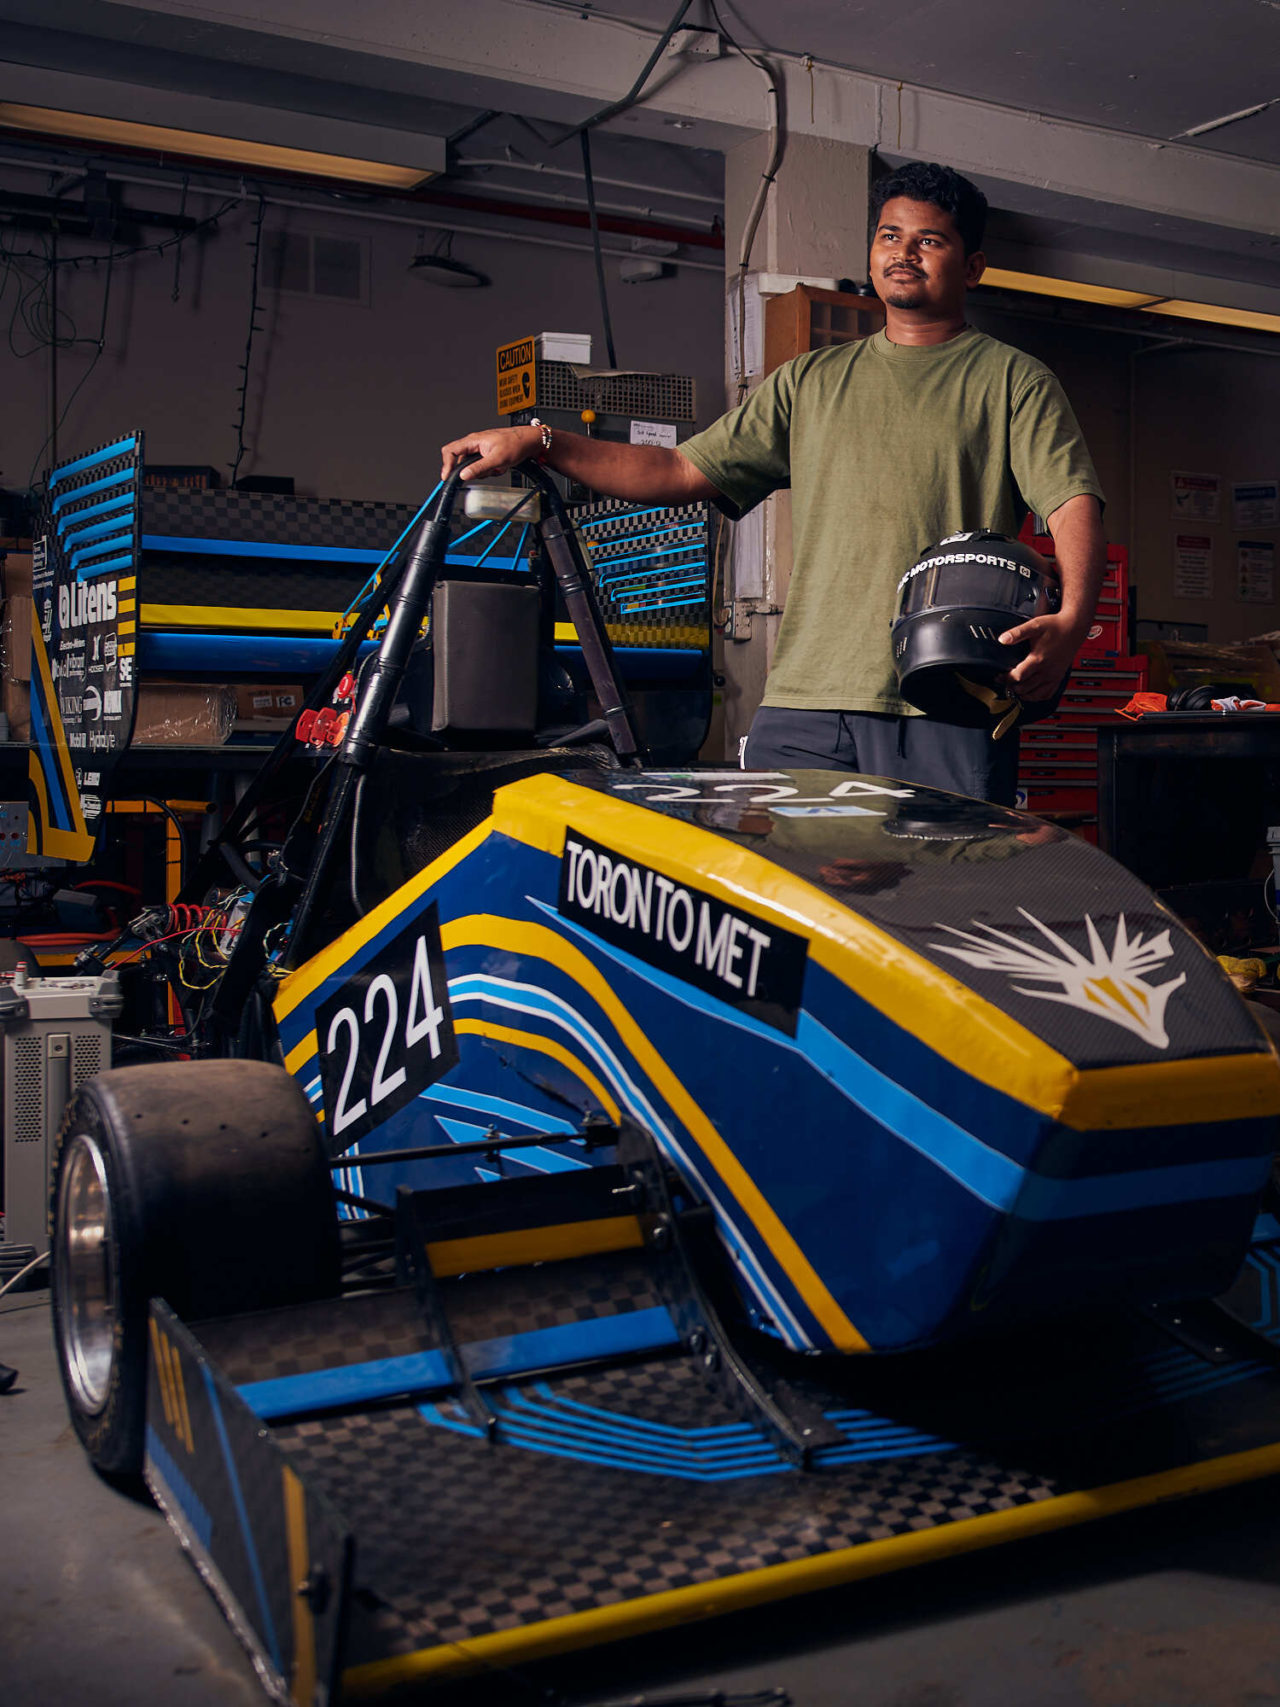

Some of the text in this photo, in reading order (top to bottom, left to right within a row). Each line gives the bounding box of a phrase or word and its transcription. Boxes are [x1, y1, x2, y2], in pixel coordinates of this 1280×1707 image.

[500, 343, 532, 371] CAUTION
[909, 553, 1018, 579] MOTORSPORTS
[70, 580, 117, 628] Litens
[612, 780, 916, 803] 224
[565, 839, 771, 999] TORONTO MET
[325, 933, 446, 1136] 224
